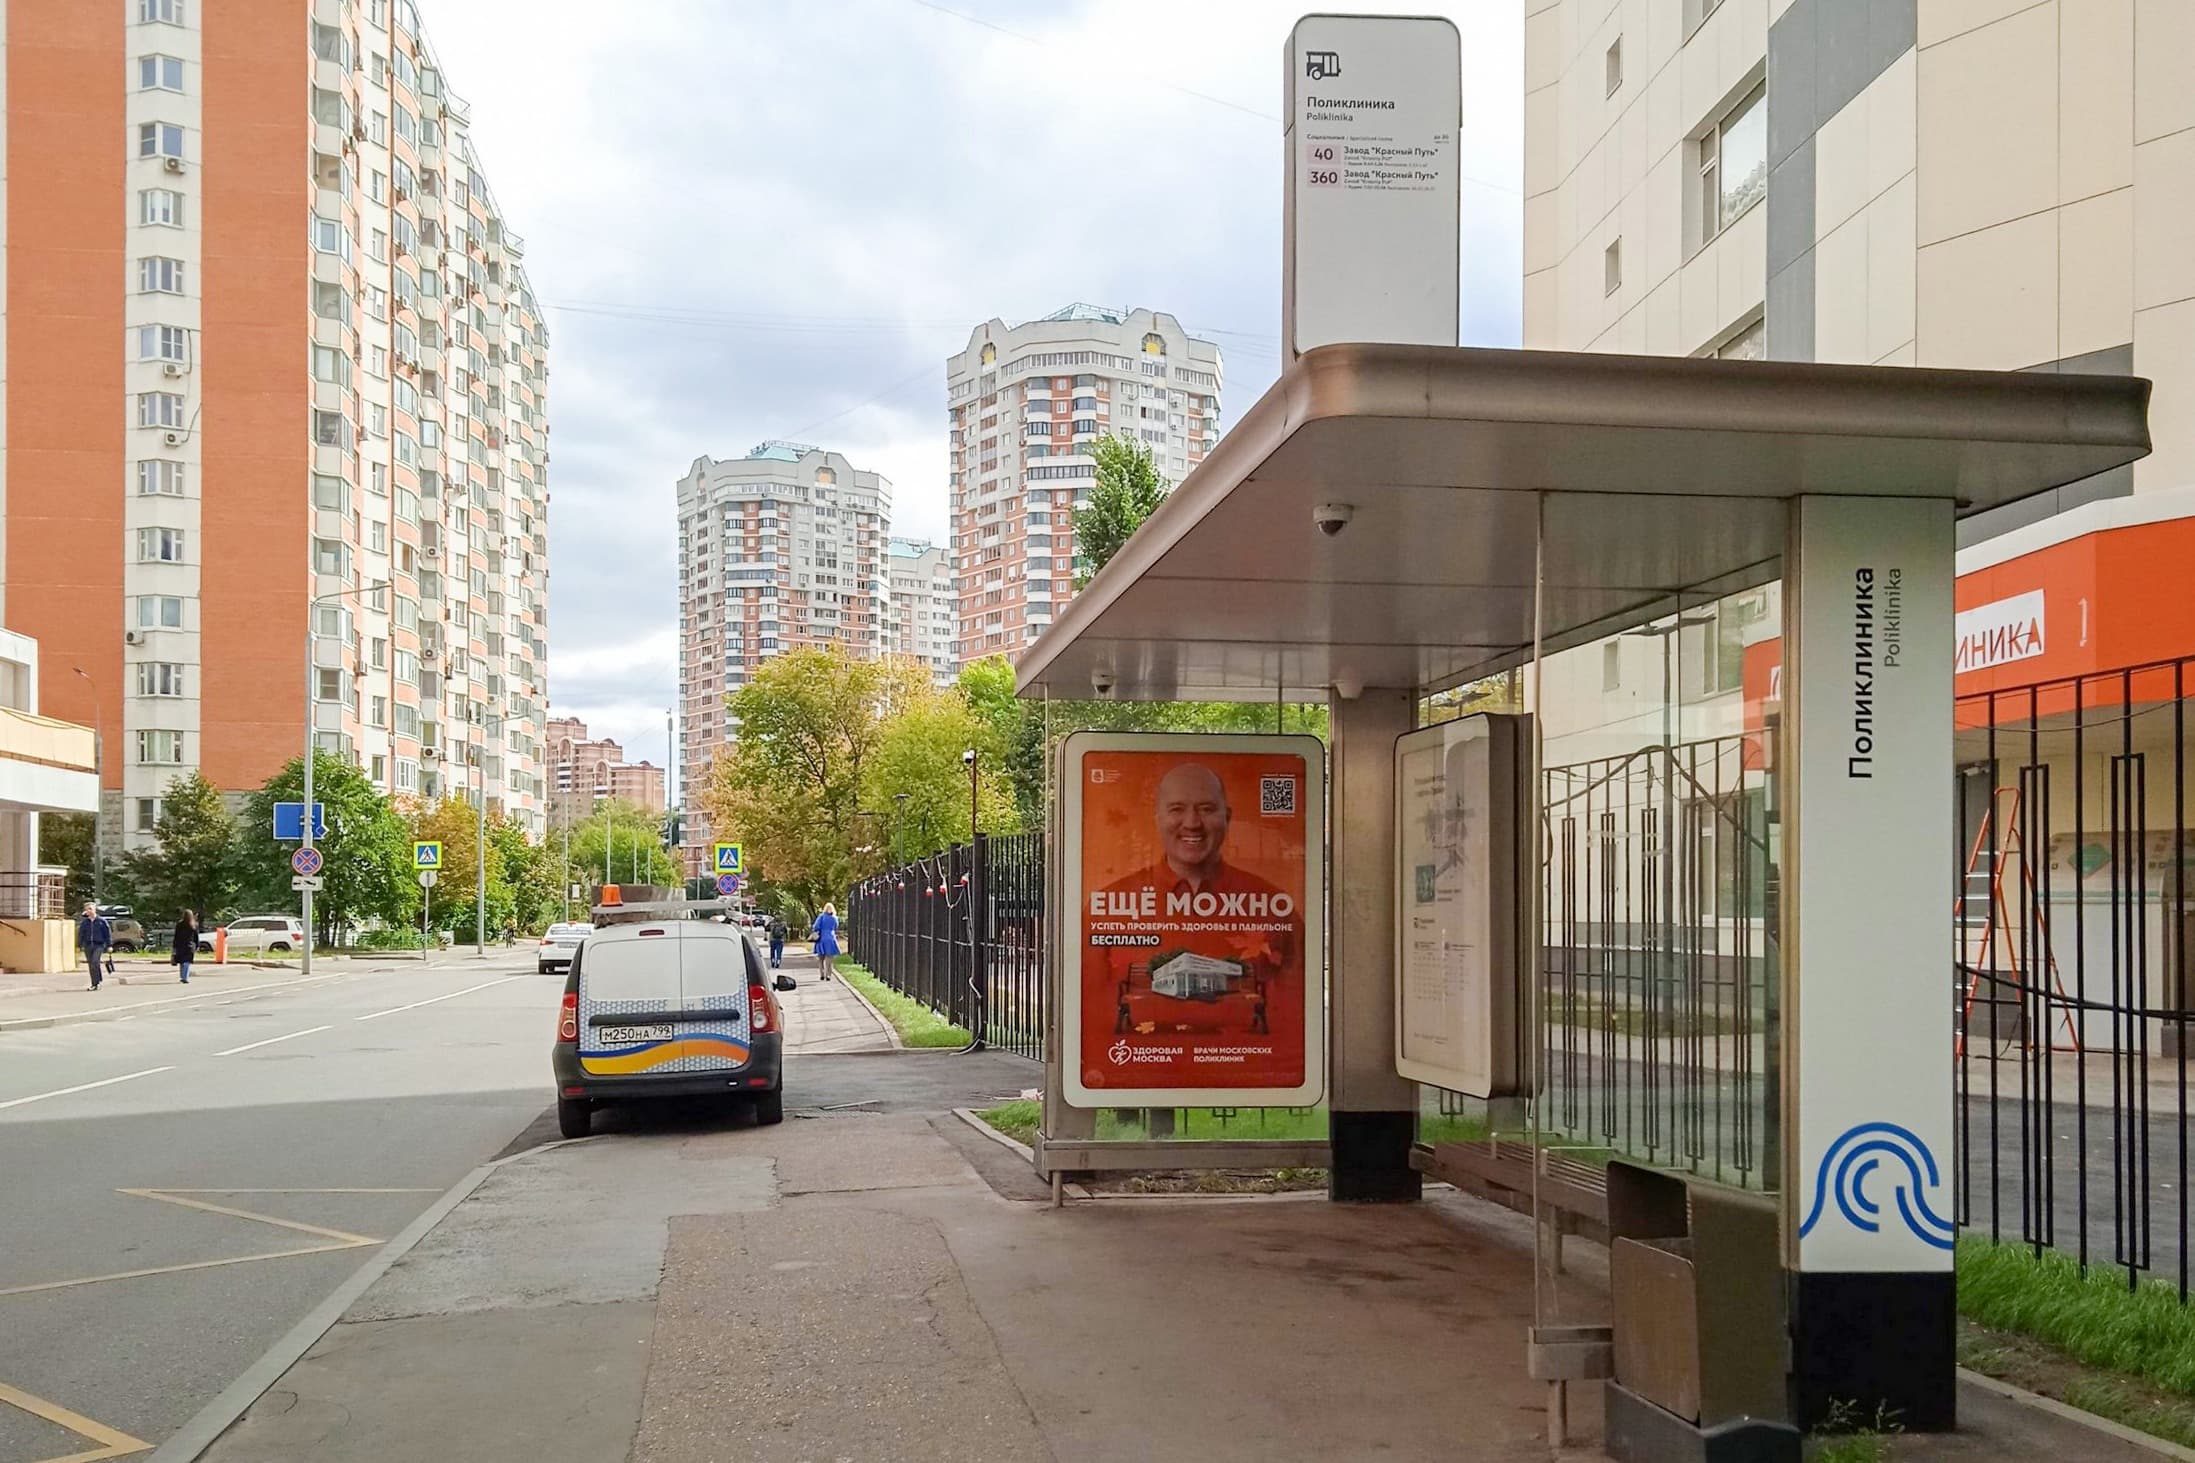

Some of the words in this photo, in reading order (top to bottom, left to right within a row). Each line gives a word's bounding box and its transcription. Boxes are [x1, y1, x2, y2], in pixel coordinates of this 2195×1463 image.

[1307, 96, 1395, 109] Поликлиника
[1306, 112, 1354, 121] Poliklinika
[1314, 147, 1334, 160] 40
[1344, 145, 1370, 155] Завод
[1310, 171, 1338, 184] 360
[1344, 169, 1370, 178] Завод
[1883, 568, 1902, 668] Poliklinika
[1848, 567, 1874, 779] Поликлиника
[1090, 886, 1157, 920] ЕЩЁ
[1166, 892, 1294, 918] МОЖНО
[1090, 922, 1126, 931] УСПЕТЬ
[1127, 922, 1180, 931] ПРОВЕРИТЬ
[1181, 922, 1230, 932] ЗДОРОВЬЕ
[1231, 923, 1238, 931] В
[1239, 923, 1294, 932] ПАВИЛЬОНЕ
[1091, 935, 1160, 946] БЕСПЛАТНО
[1132, 1047, 1183, 1055] ЗДОРОВАЯ
[1193, 1047, 1218, 1055] ВРАЧИ
[1219, 1047, 1272, 1055] МОСКОВСКИХ
[1132, 1055, 1173, 1063] МОСКВА
[1193, 1055, 1245, 1063] ПОЛИКЛИНИК
